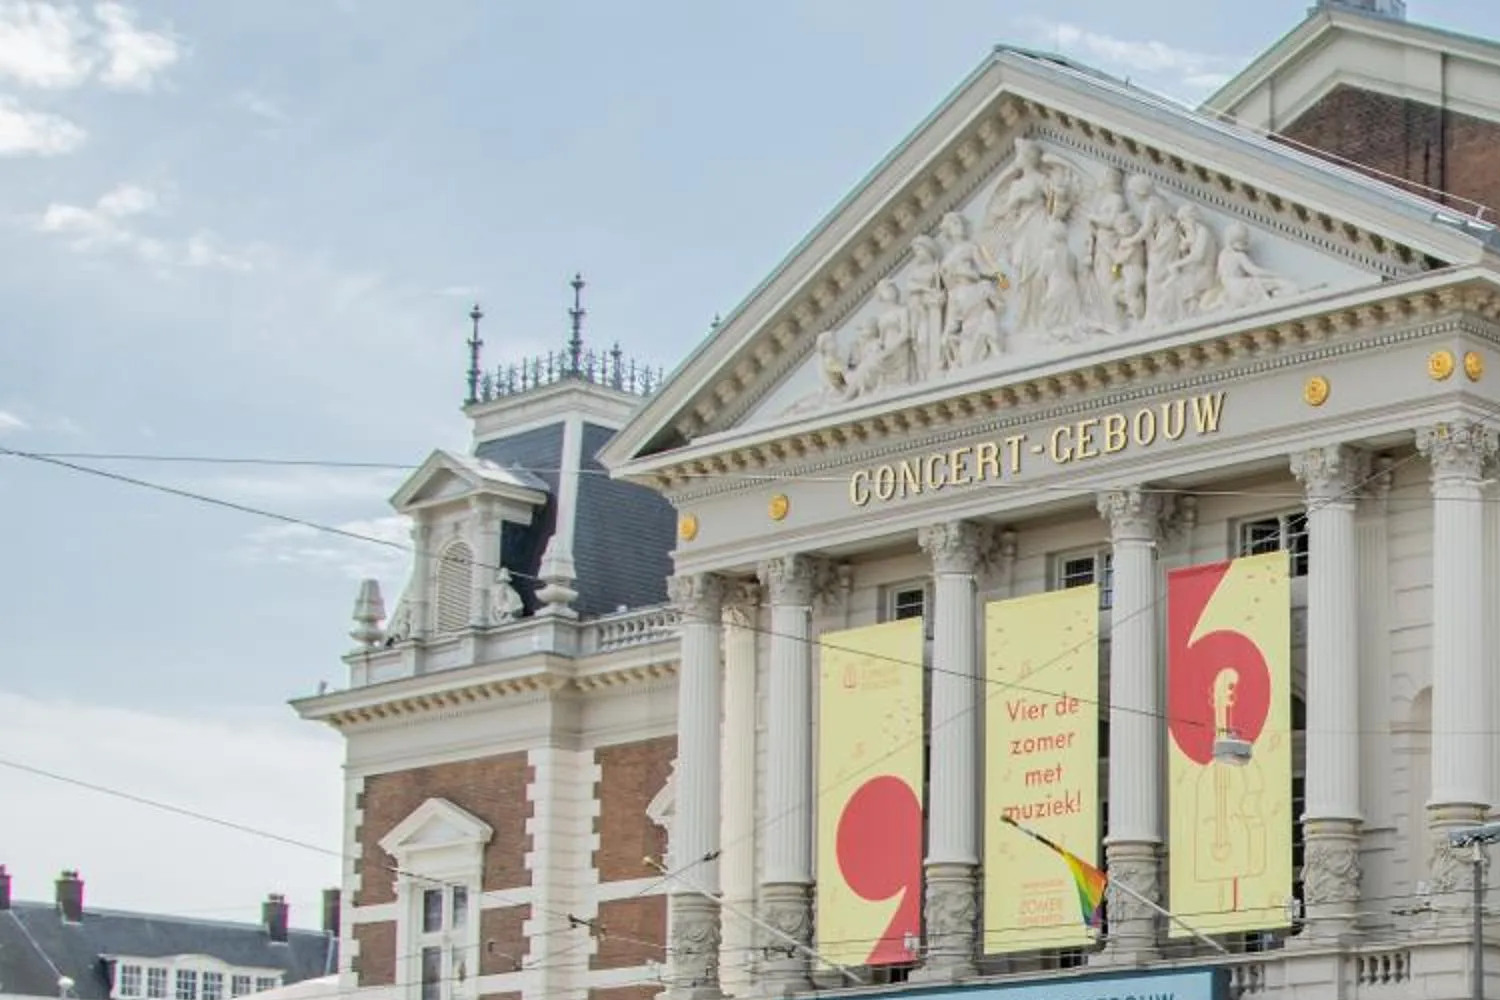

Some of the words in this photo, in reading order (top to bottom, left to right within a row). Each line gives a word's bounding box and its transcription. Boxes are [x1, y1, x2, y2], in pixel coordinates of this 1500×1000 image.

[849, 391, 1227, 506] CONCERT-GEBOUW
[1006, 699, 1048, 721] Vier
[1055, 691, 1080, 716] de
[1010, 731, 1074, 754] zomer
[1024, 762, 1063, 785] met
[1002, 790, 1081, 820] muziek!
